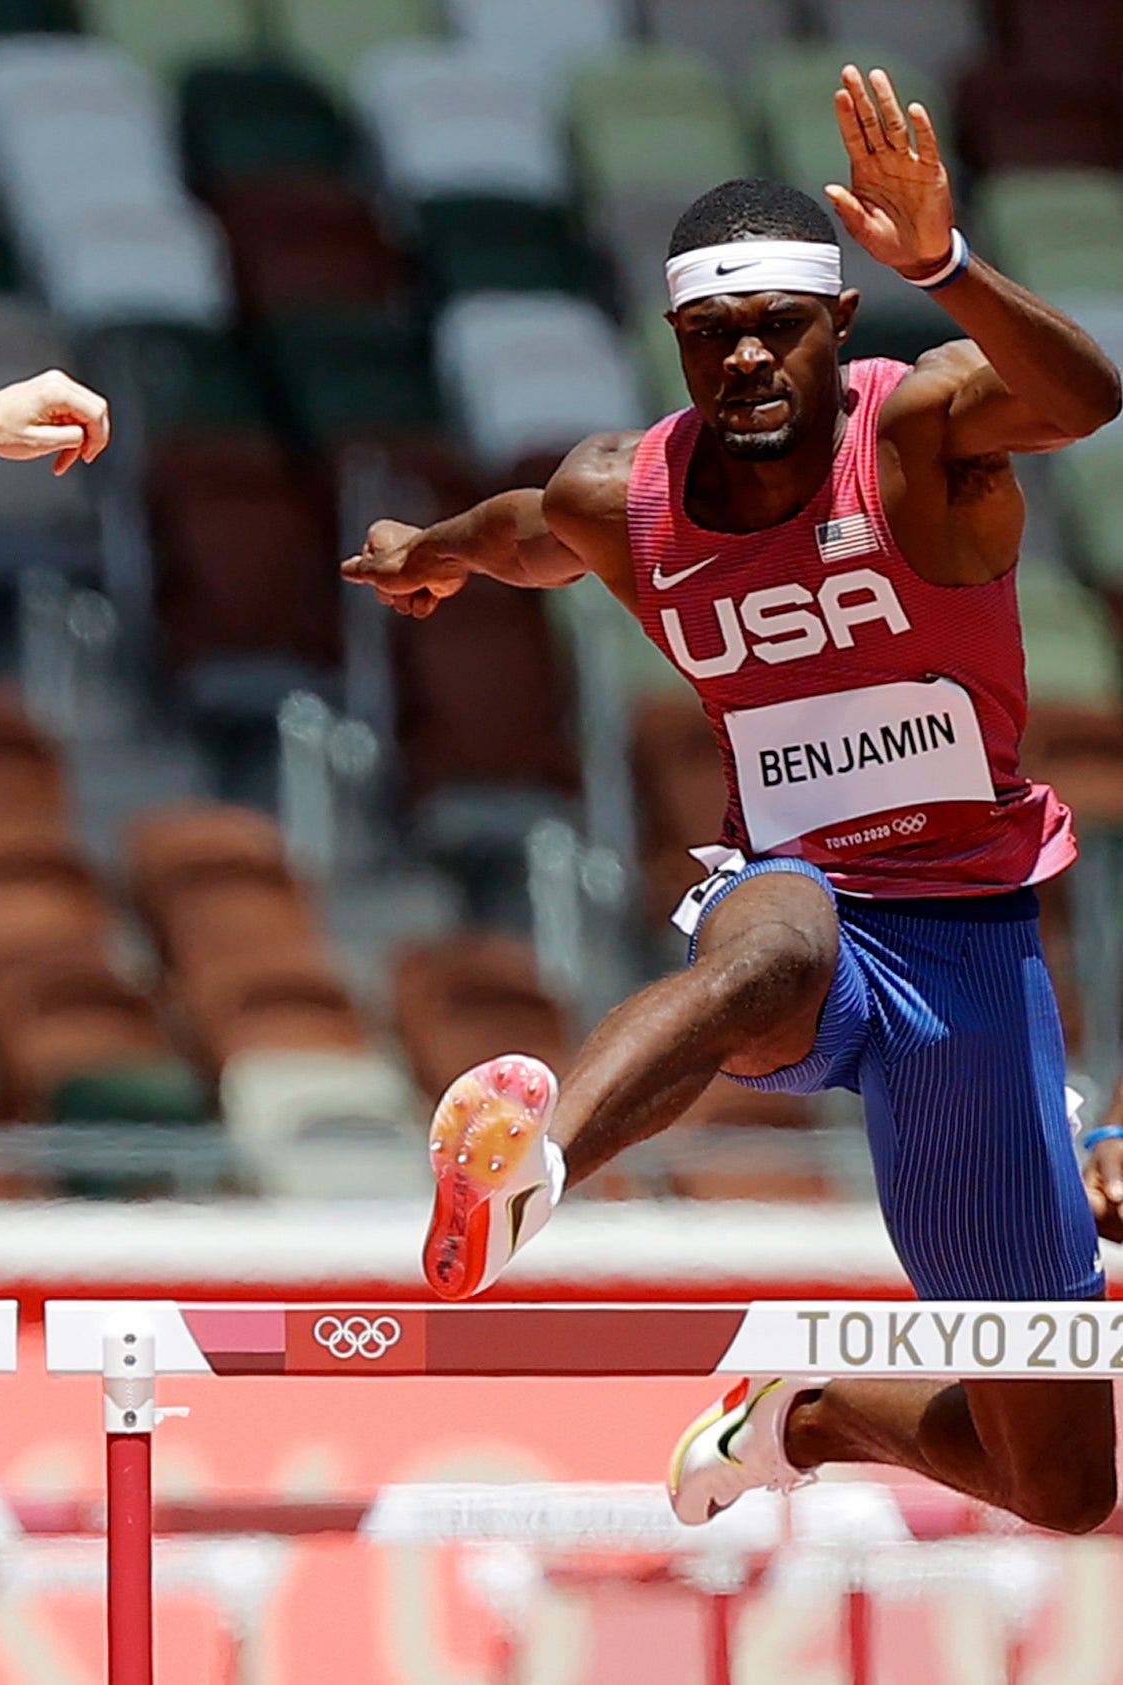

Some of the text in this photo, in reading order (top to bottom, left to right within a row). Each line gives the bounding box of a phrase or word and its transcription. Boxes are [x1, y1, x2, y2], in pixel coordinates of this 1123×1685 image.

[660, 568, 912, 680] USA
[759, 711, 956, 788] BENJAMIN
[824, 824, 891, 850] TOKYO 2020
[796, 1311, 1006, 1367] TOKYO
